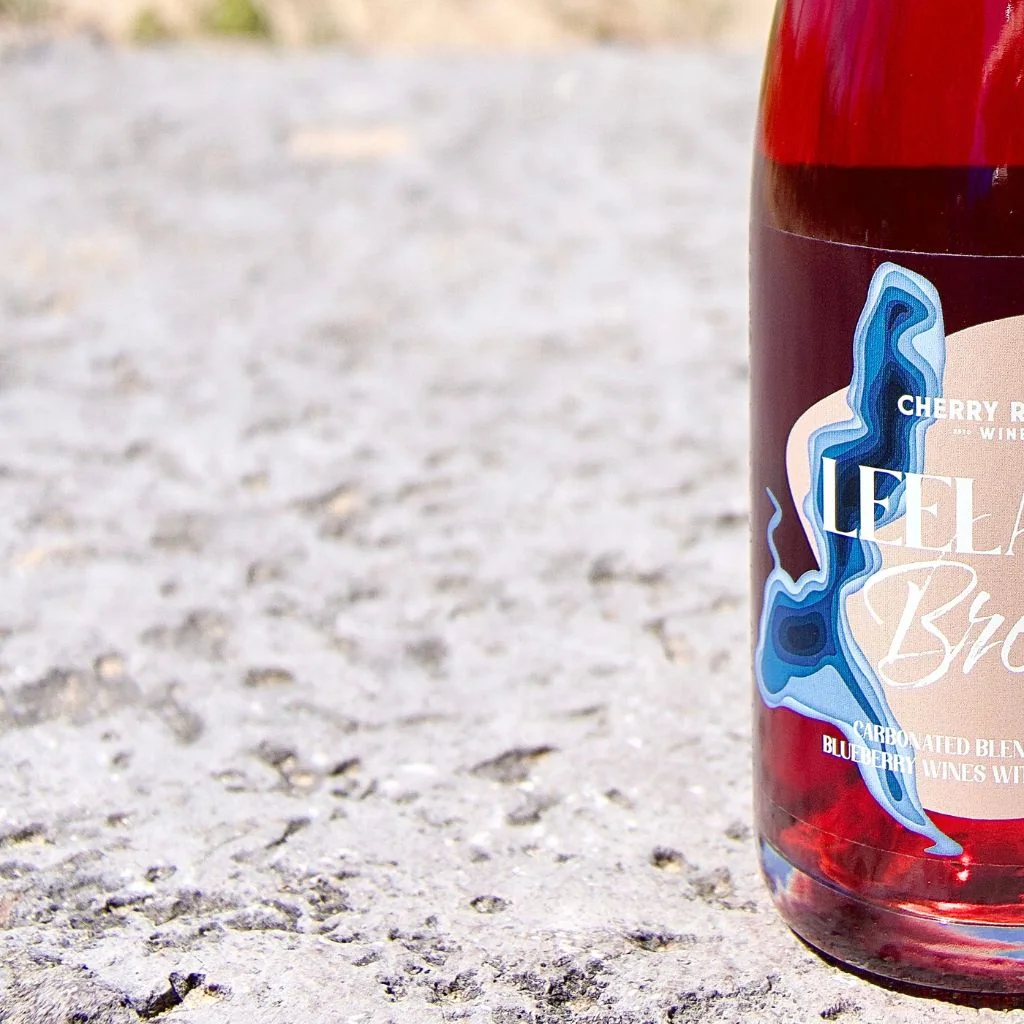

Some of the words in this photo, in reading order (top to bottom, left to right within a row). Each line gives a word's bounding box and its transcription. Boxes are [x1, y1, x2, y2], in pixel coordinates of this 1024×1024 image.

[897, 394, 999, 422] CHERRY
[853, 720, 970, 756] CARBONATED
[822, 734, 916, 775] BLUEBERRY
[922, 760, 985, 783] WINES
